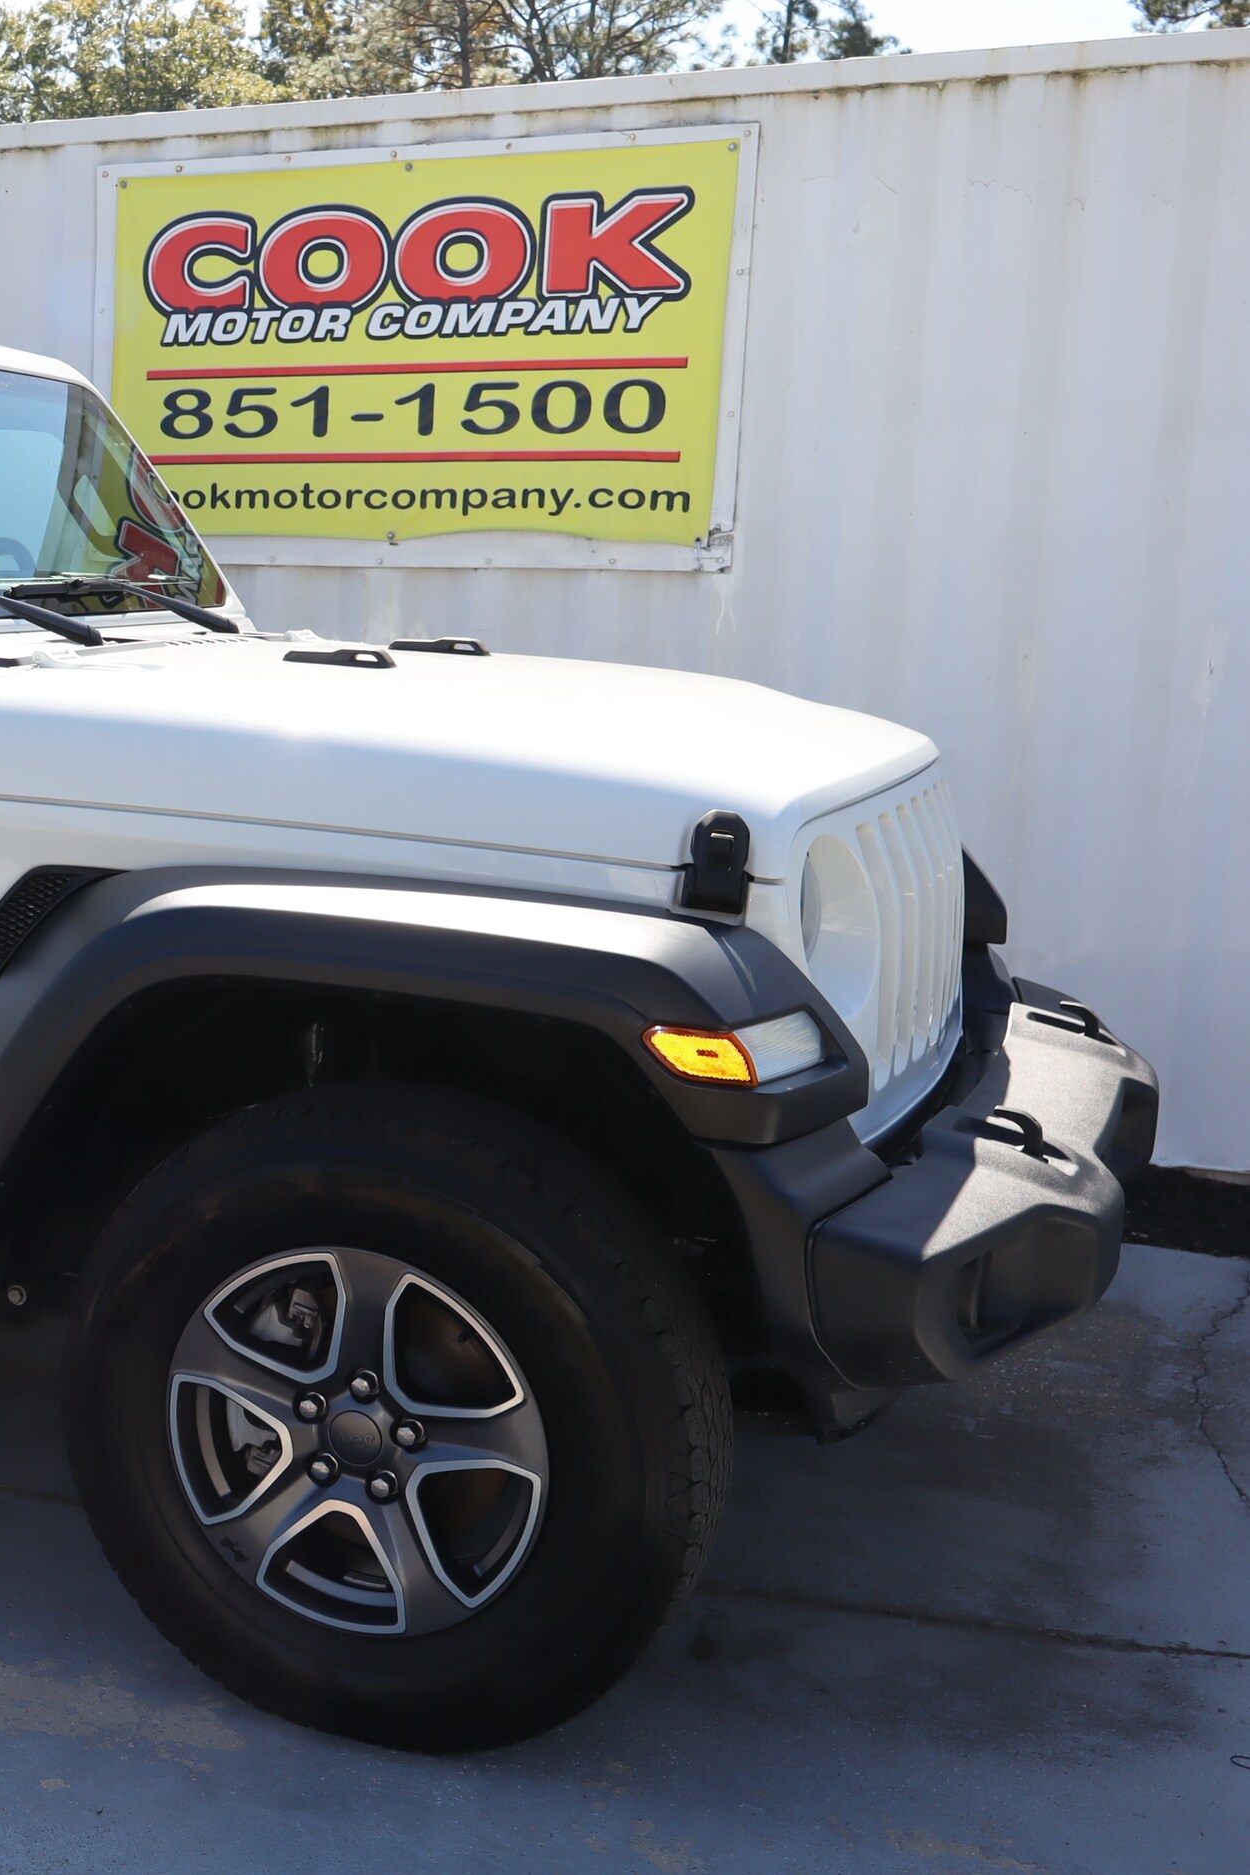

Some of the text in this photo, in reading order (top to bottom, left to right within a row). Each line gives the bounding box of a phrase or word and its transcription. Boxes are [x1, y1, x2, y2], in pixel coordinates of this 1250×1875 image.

[144, 187, 694, 312] COOK
[161, 296, 662, 345] MOTOR COMPANY
[160, 379, 667, 439] 851-1500
[169, 481, 691, 516] okmotorcompany.com
